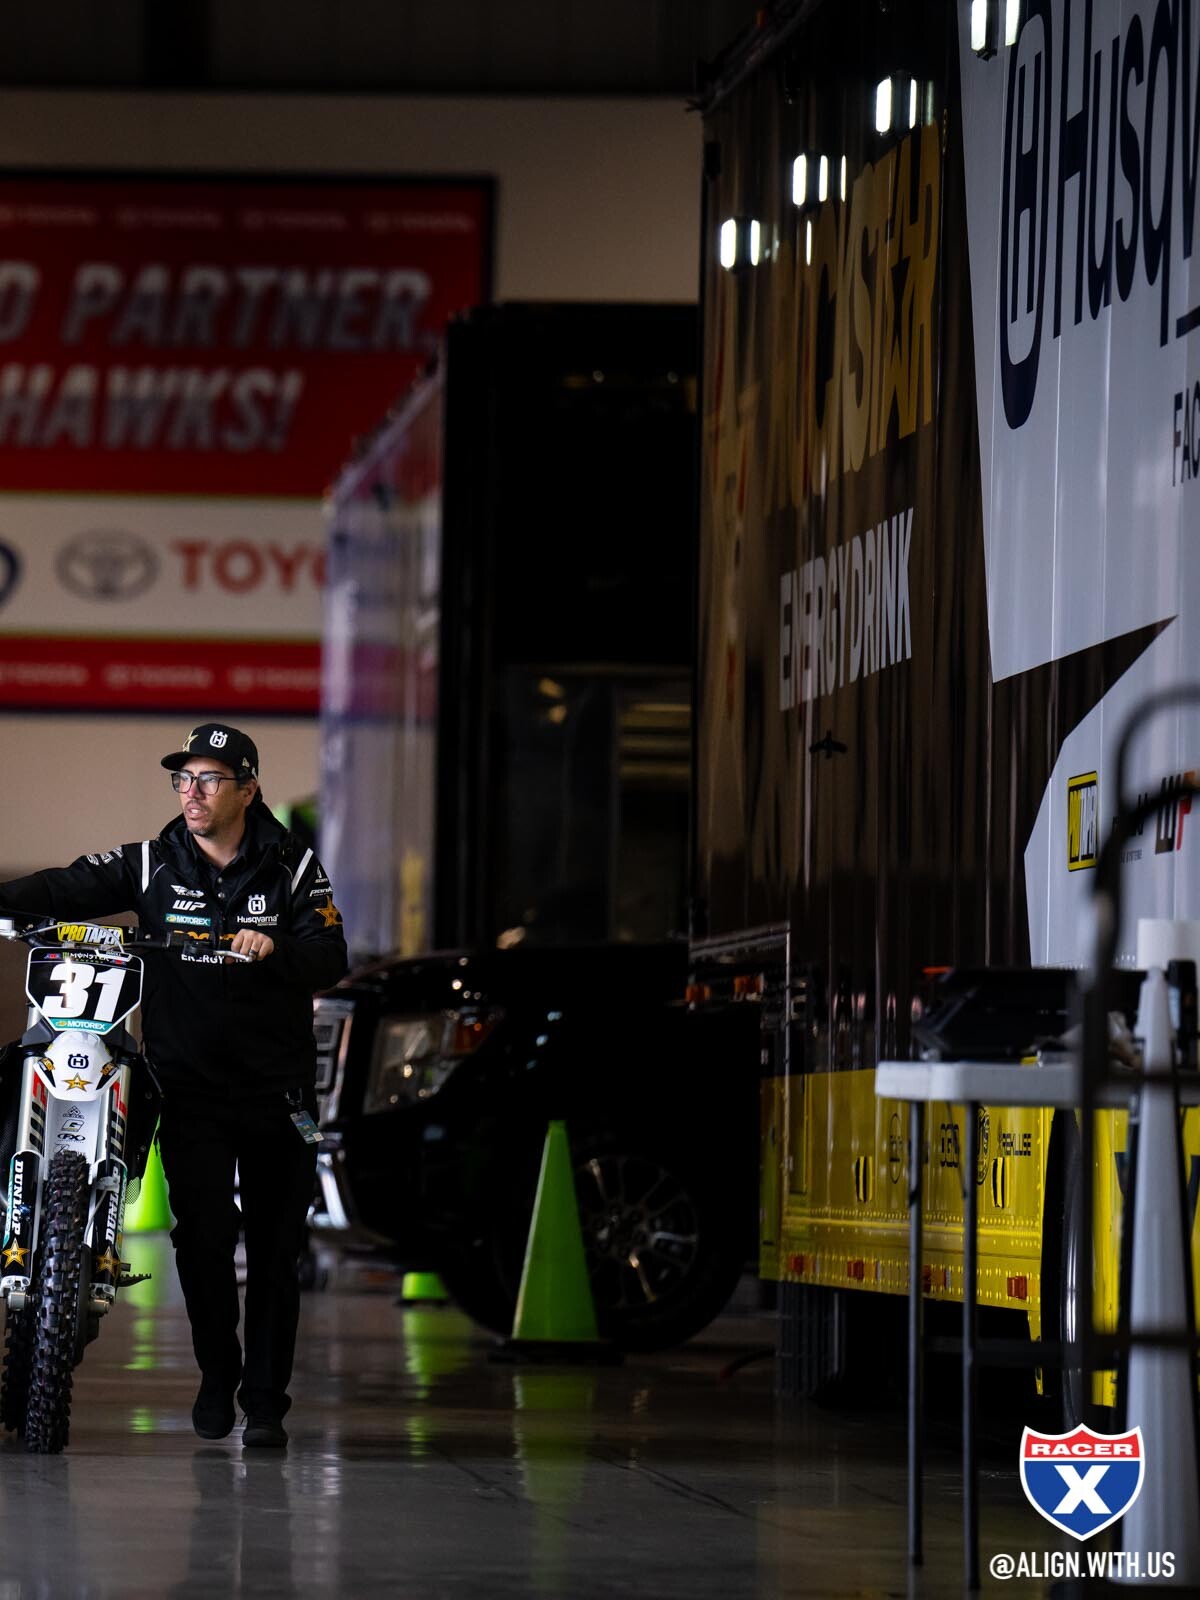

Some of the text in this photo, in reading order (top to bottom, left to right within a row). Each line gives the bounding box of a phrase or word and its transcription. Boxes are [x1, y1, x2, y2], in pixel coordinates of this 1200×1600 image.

[780, 507, 914, 712] ENERGY DRINK
[172, 900, 207, 911] WP
[176, 915, 209, 926] MOTOREX
[237, 915, 278, 925] Husqvarna
[60, 924, 121, 945] PROTAPER
[42, 962, 127, 1022] 31
[67, 1020, 106, 1030] MOTOREX
[11, 1160, 24, 1236] DUNLOP
[105, 1166, 121, 1245] DUNLP
